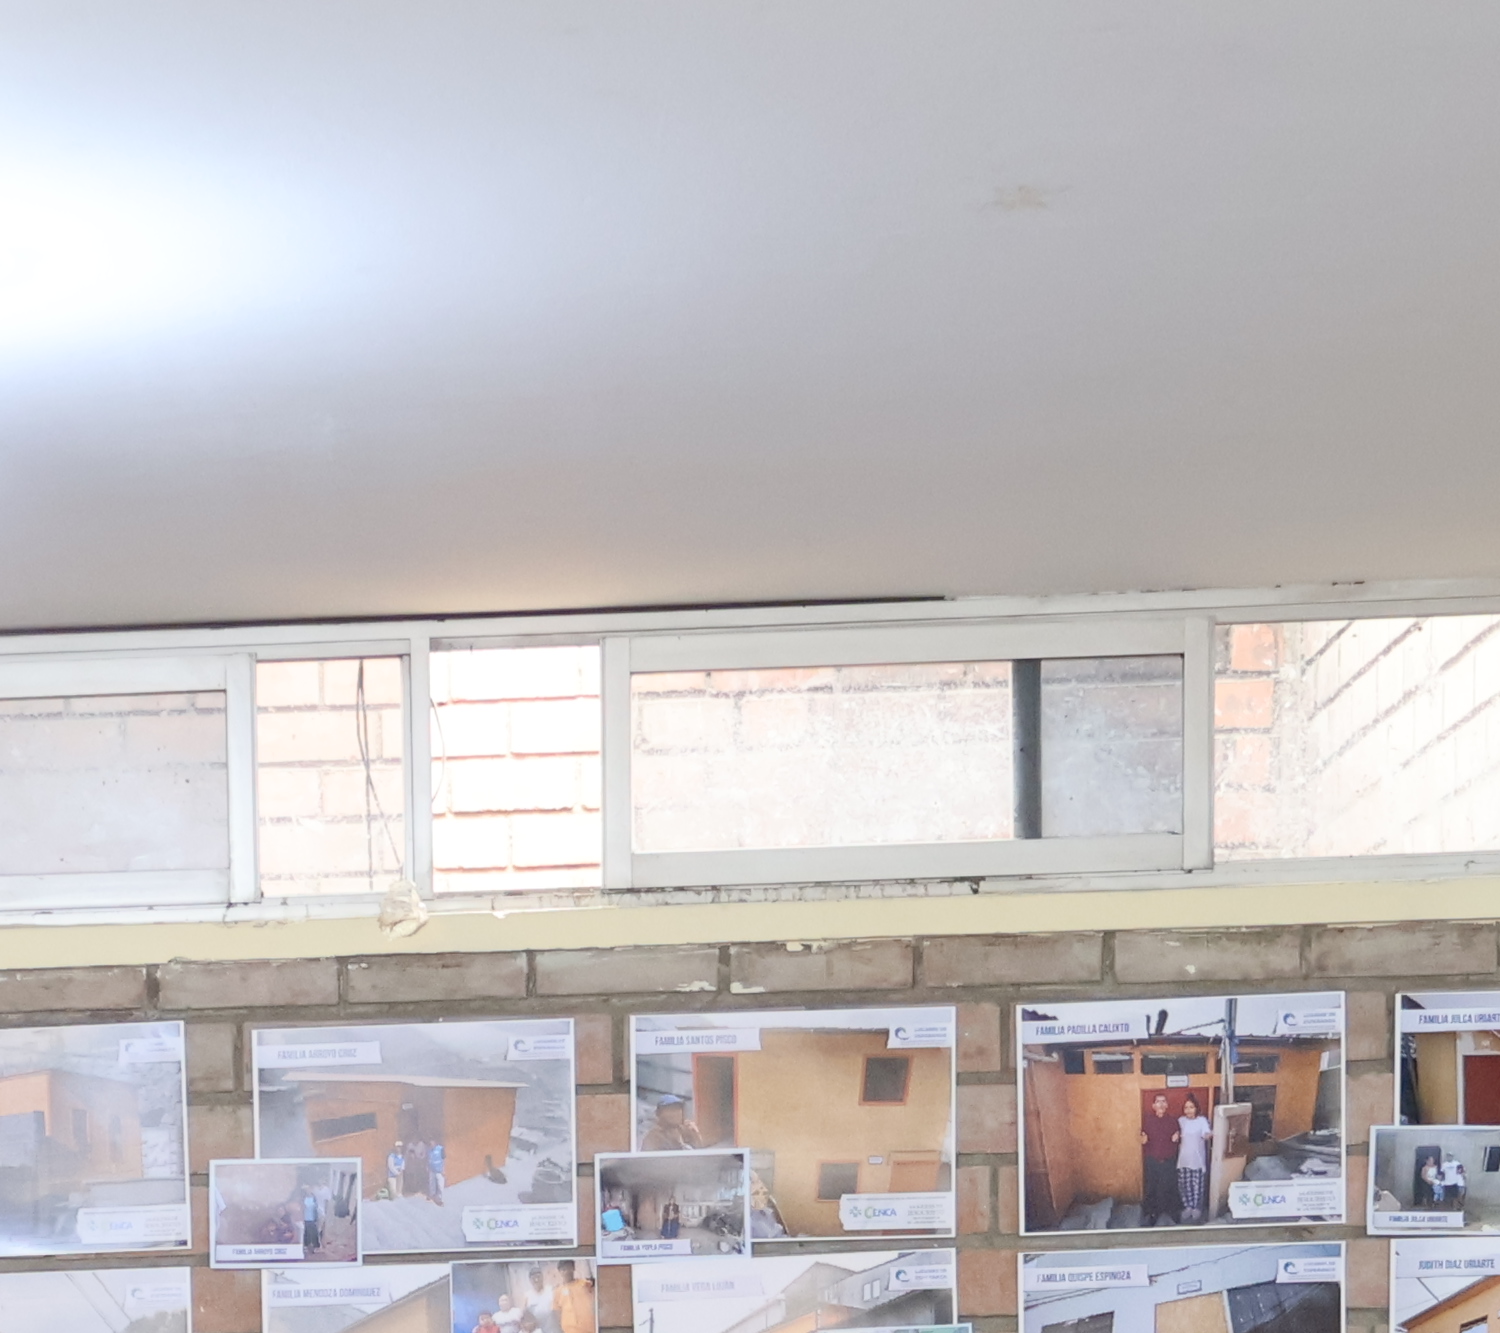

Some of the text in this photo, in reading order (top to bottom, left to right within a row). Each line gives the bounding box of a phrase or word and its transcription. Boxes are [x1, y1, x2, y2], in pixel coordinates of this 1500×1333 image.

[1419, 1014, 1448, 1025] FAMILIA
[1036, 1026, 1065, 1036] FAMILIA
[1067, 1024, 1097, 1035] PADILLA
[655, 1035, 684, 1047] FAMILIA
[686, 1035, 714, 1046] SANTOS
[277, 1049, 307, 1059] FAMILIA
[1418, 1258, 1494, 1270] JUDITH DIAZ URIARTE
[1037, 1273, 1066, 1283] FAMILIA
[1095, 1270, 1131, 1281] ESPINOZA
[661, 1282, 690, 1293] FAMILIA
[272, 1289, 301, 1299] FAMILIA
[303, 1288, 338, 1298] MENDOZA
